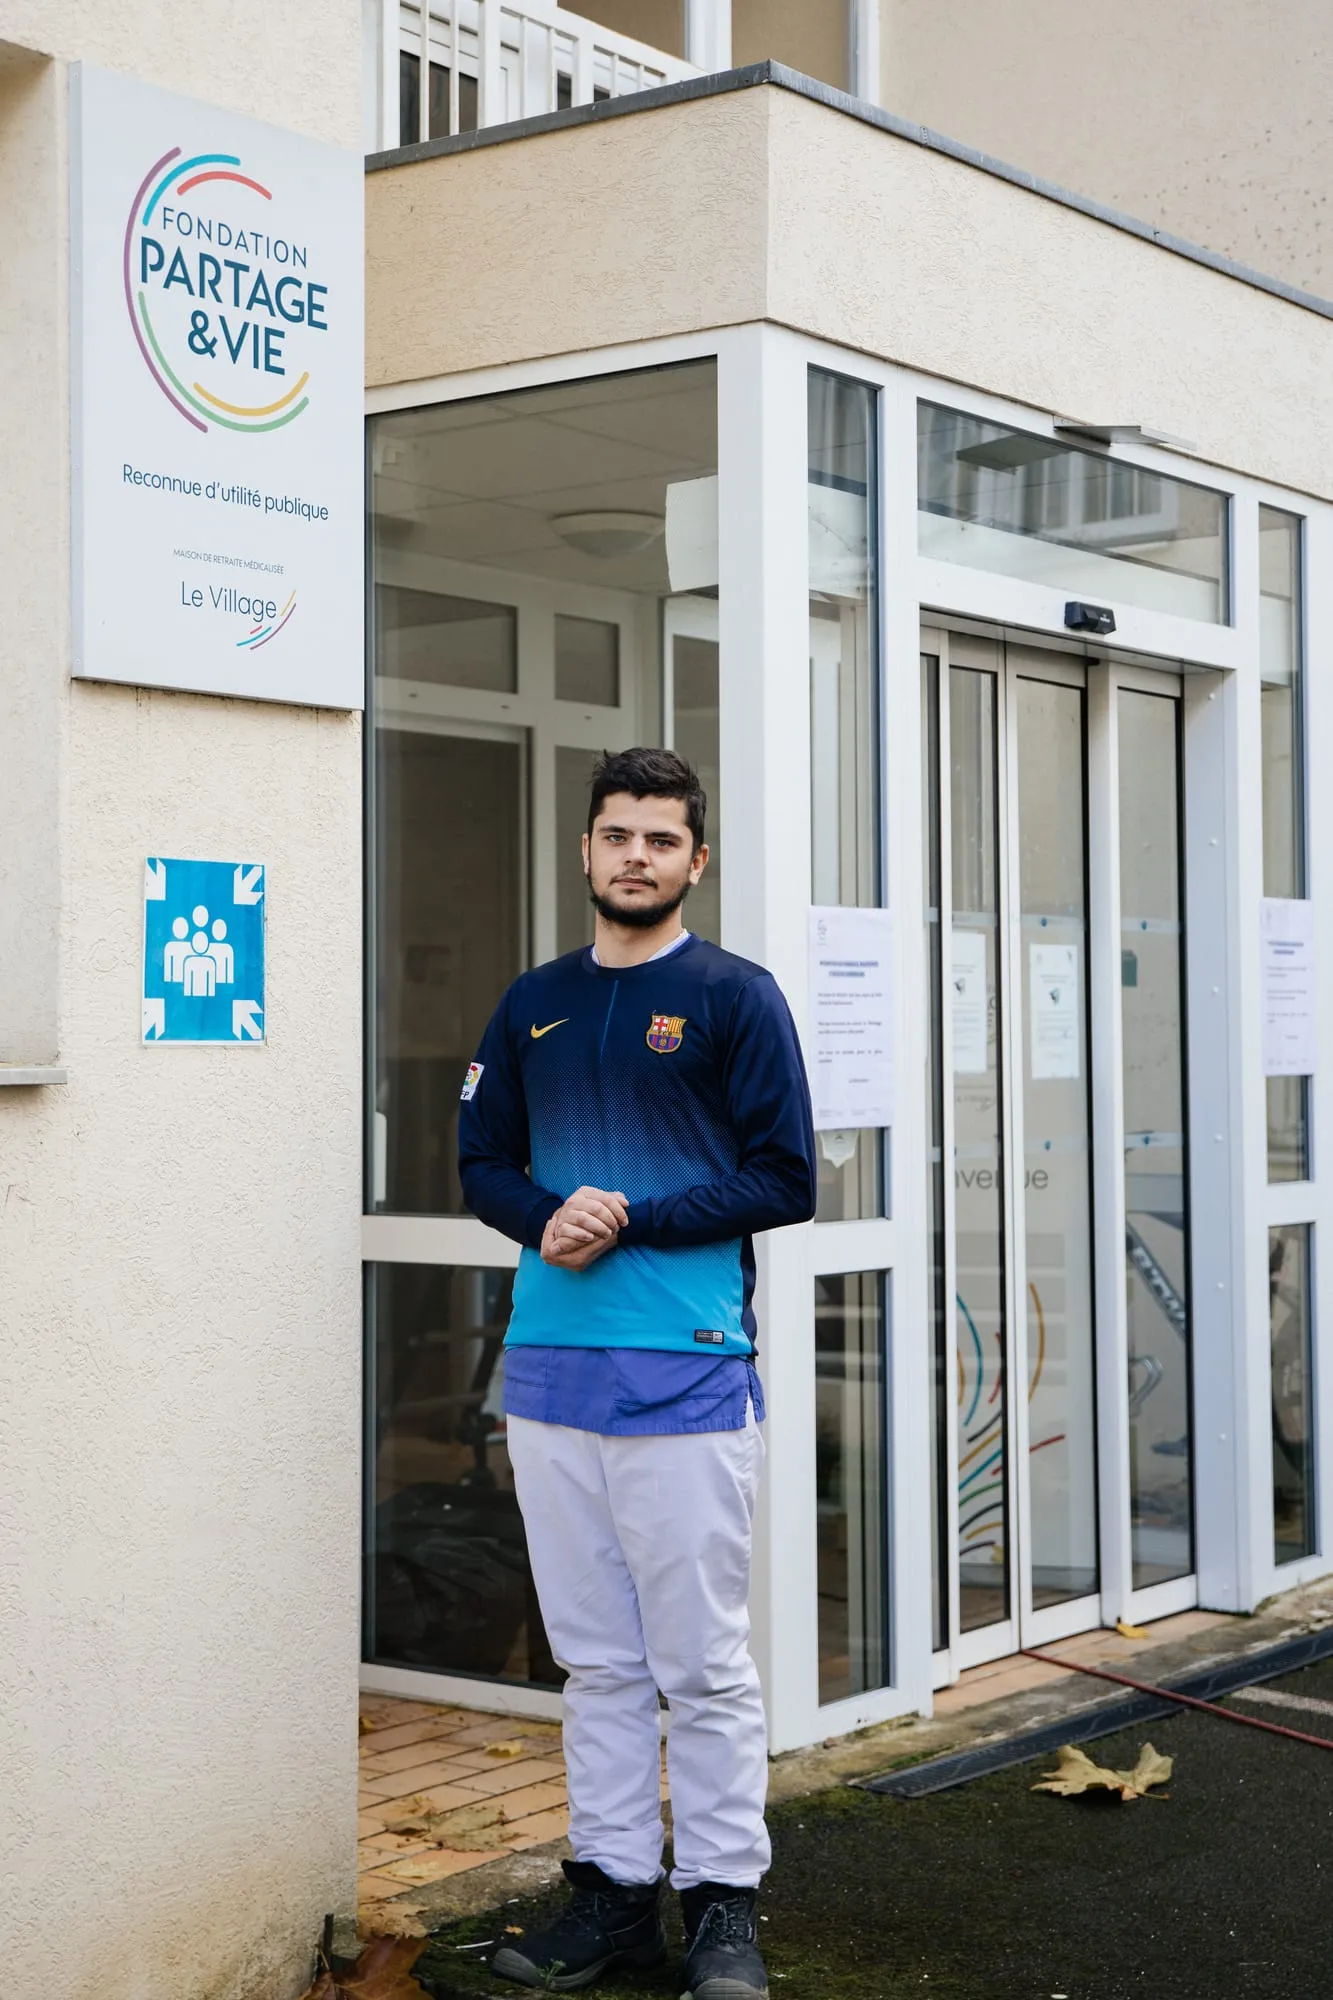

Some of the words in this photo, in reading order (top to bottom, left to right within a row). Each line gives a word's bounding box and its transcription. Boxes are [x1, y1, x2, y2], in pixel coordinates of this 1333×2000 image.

[163, 207, 307, 269] FONDATION
[141, 236, 328, 330] PARTAGE
[123, 463, 202, 496] Reconnue
[264, 496, 329, 522] publique
[173, 549, 203, 560] MAISON
[203, 553, 212, 563] DE
[213, 555, 243, 568] RETRAITE
[243, 560, 285, 575] MÉDICALISÉE
[181, 581, 203, 608] Le
[209, 585, 277, 623] Village
